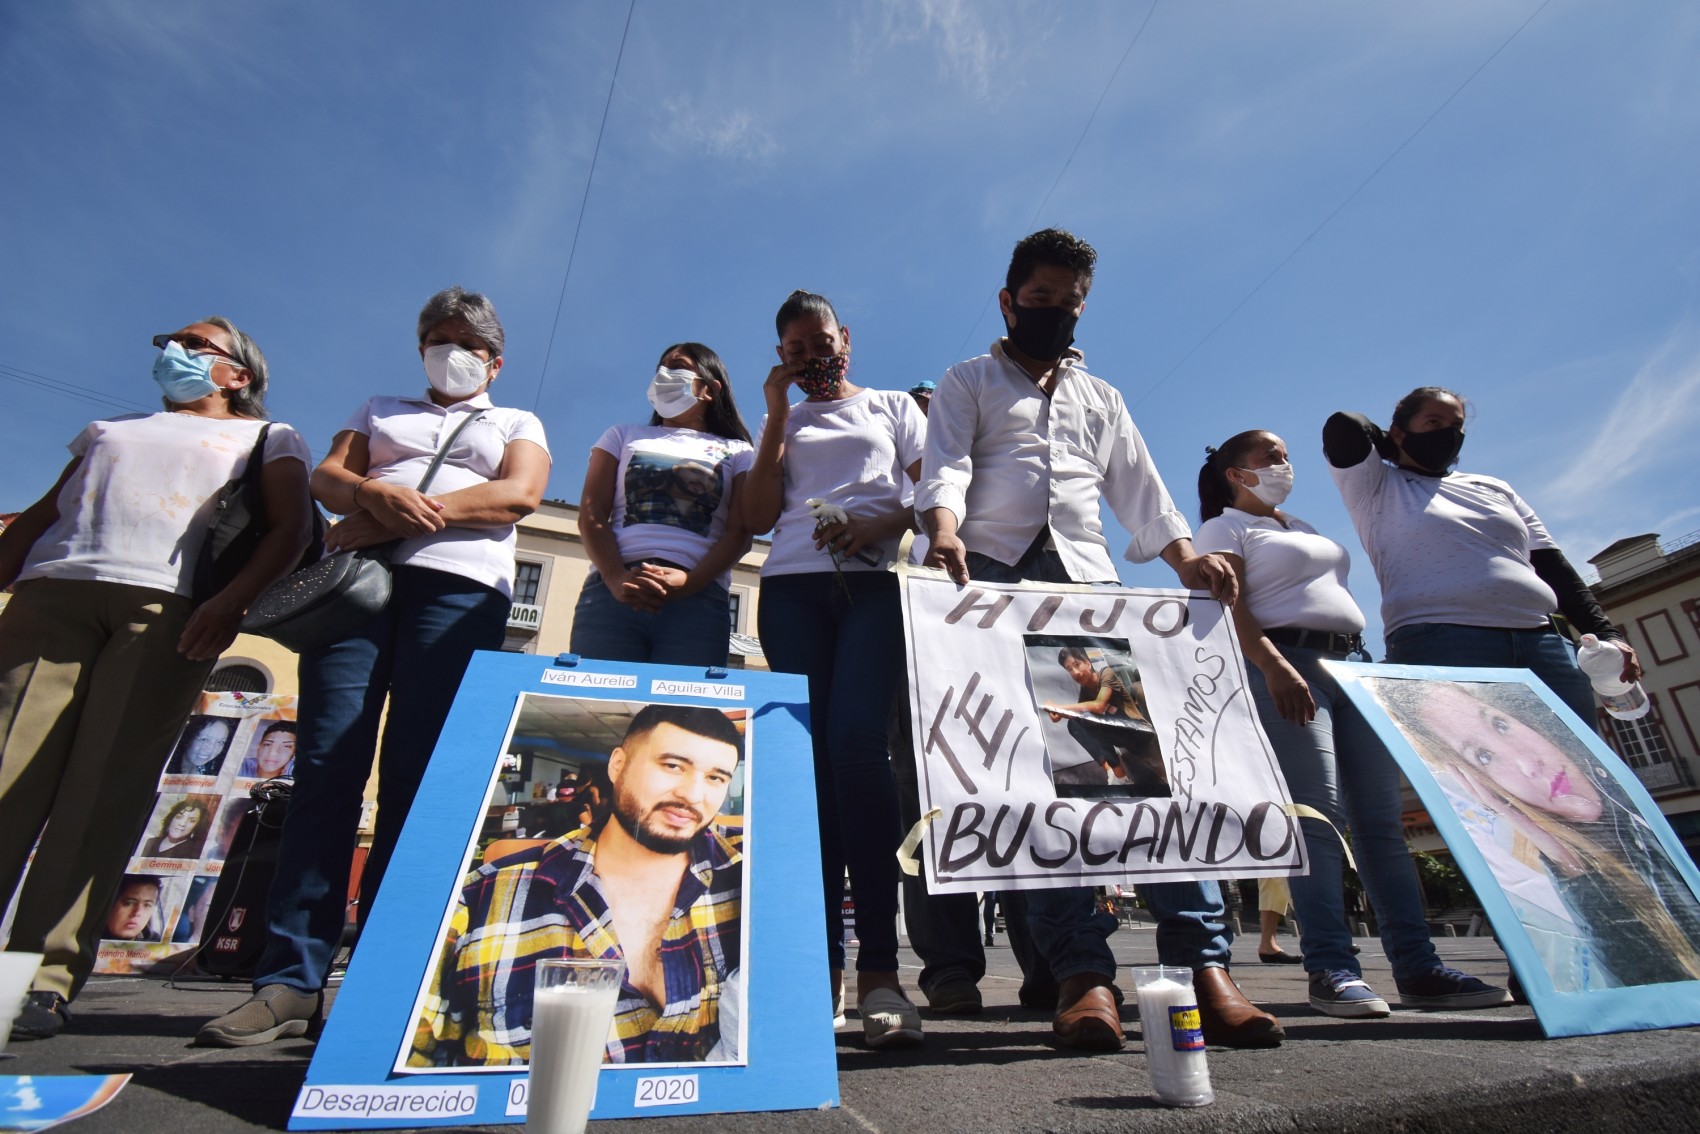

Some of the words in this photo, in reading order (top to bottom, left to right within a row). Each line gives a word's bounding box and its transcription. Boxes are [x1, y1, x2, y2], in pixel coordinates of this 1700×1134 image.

[944, 590, 1190, 637] HIJO
[543, 670, 576, 683] Iván
[581, 673, 635, 687] Aurelio
[656, 681, 709, 695] Aguilar
[712, 684, 742, 697] Villa
[925, 671, 1016, 795] TE
[1171, 647, 1225, 803] ESTAMOS
[938, 801, 1294, 874] BUSCANDO
[149, 860, 183, 869] Gemma
[206, 864, 221, 872] Jon
[97, 949, 124, 958] ejandro
[125, 950, 151, 958] Manuel
[216, 938, 238, 950] KSR
[510, 1083, 527, 1106] 0
[639, 1078, 695, 1101] 2020
[301, 1088, 475, 1117] Desaparecido
